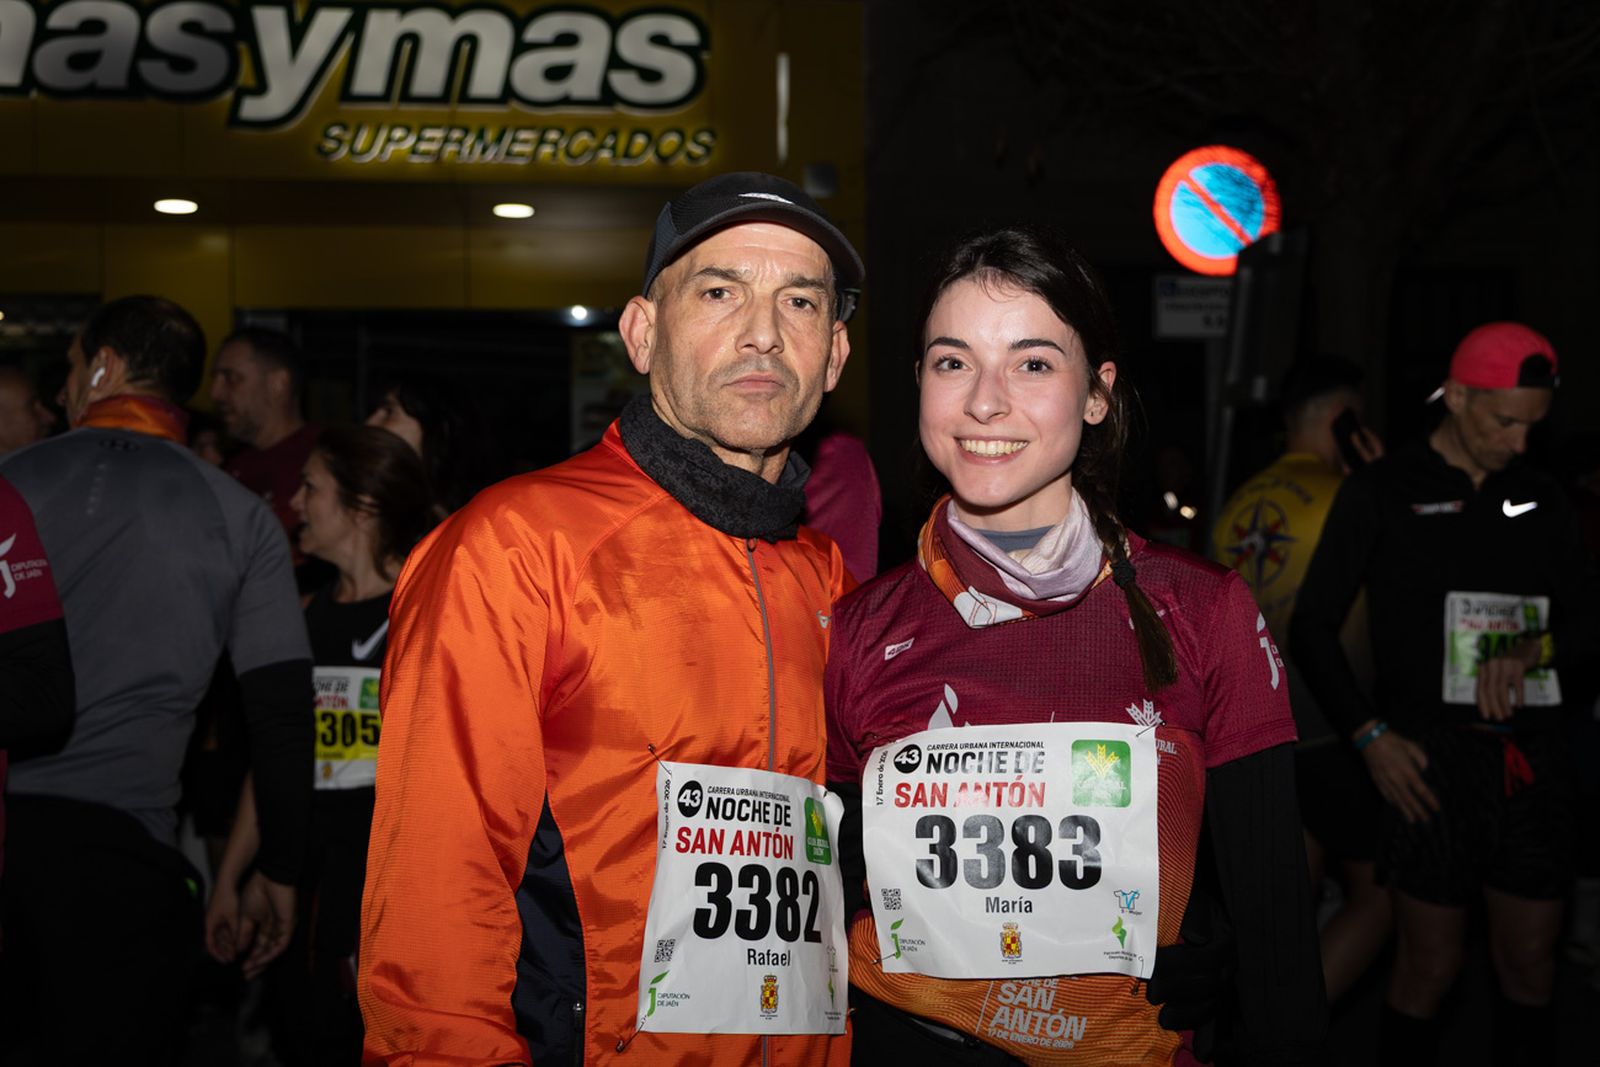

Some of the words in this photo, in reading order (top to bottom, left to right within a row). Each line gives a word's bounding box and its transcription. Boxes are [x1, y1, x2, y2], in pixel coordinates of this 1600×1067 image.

[317, 122, 716, 167] SUPERMERCADOS
[927, 743, 958, 751] CARRERA
[959, 742, 988, 750] URBANA
[989, 741, 1045, 750] INTERNACIONAL
[1154, 739, 1177, 755] URAL
[895, 749, 919, 766] 43
[926, 751, 1008, 774] NOCHE
[1014, 751, 1045, 774] DE
[707, 786, 736, 795] CARRERA
[736, 787, 758, 797] URBANA
[876, 773, 884, 795] Enero
[894, 782, 949, 808] SAN
[953, 775, 1046, 808] ANTÓN
[678, 789, 701, 808] 43
[876, 796, 884, 806] 17
[705, 797, 770, 824] NOCHE
[774, 803, 792, 827] DE
[675, 826, 725, 854] SAN
[729, 827, 794, 860] ANTÓN
[915, 814, 1102, 890] 3383
[692, 862, 822, 944] 3382
[985, 896, 1033, 914] María
[747, 948, 791, 967] Rafael
[657, 991, 690, 1000] DIPUTACIÓN
[997, 982, 1056, 1011] SAN
[990, 1008, 1088, 1041] ANTÓN
[996, 1030, 1009, 1041] DE
[1009, 1032, 1040, 1045] ENERO
[1040, 1038, 1052, 1047] DE
